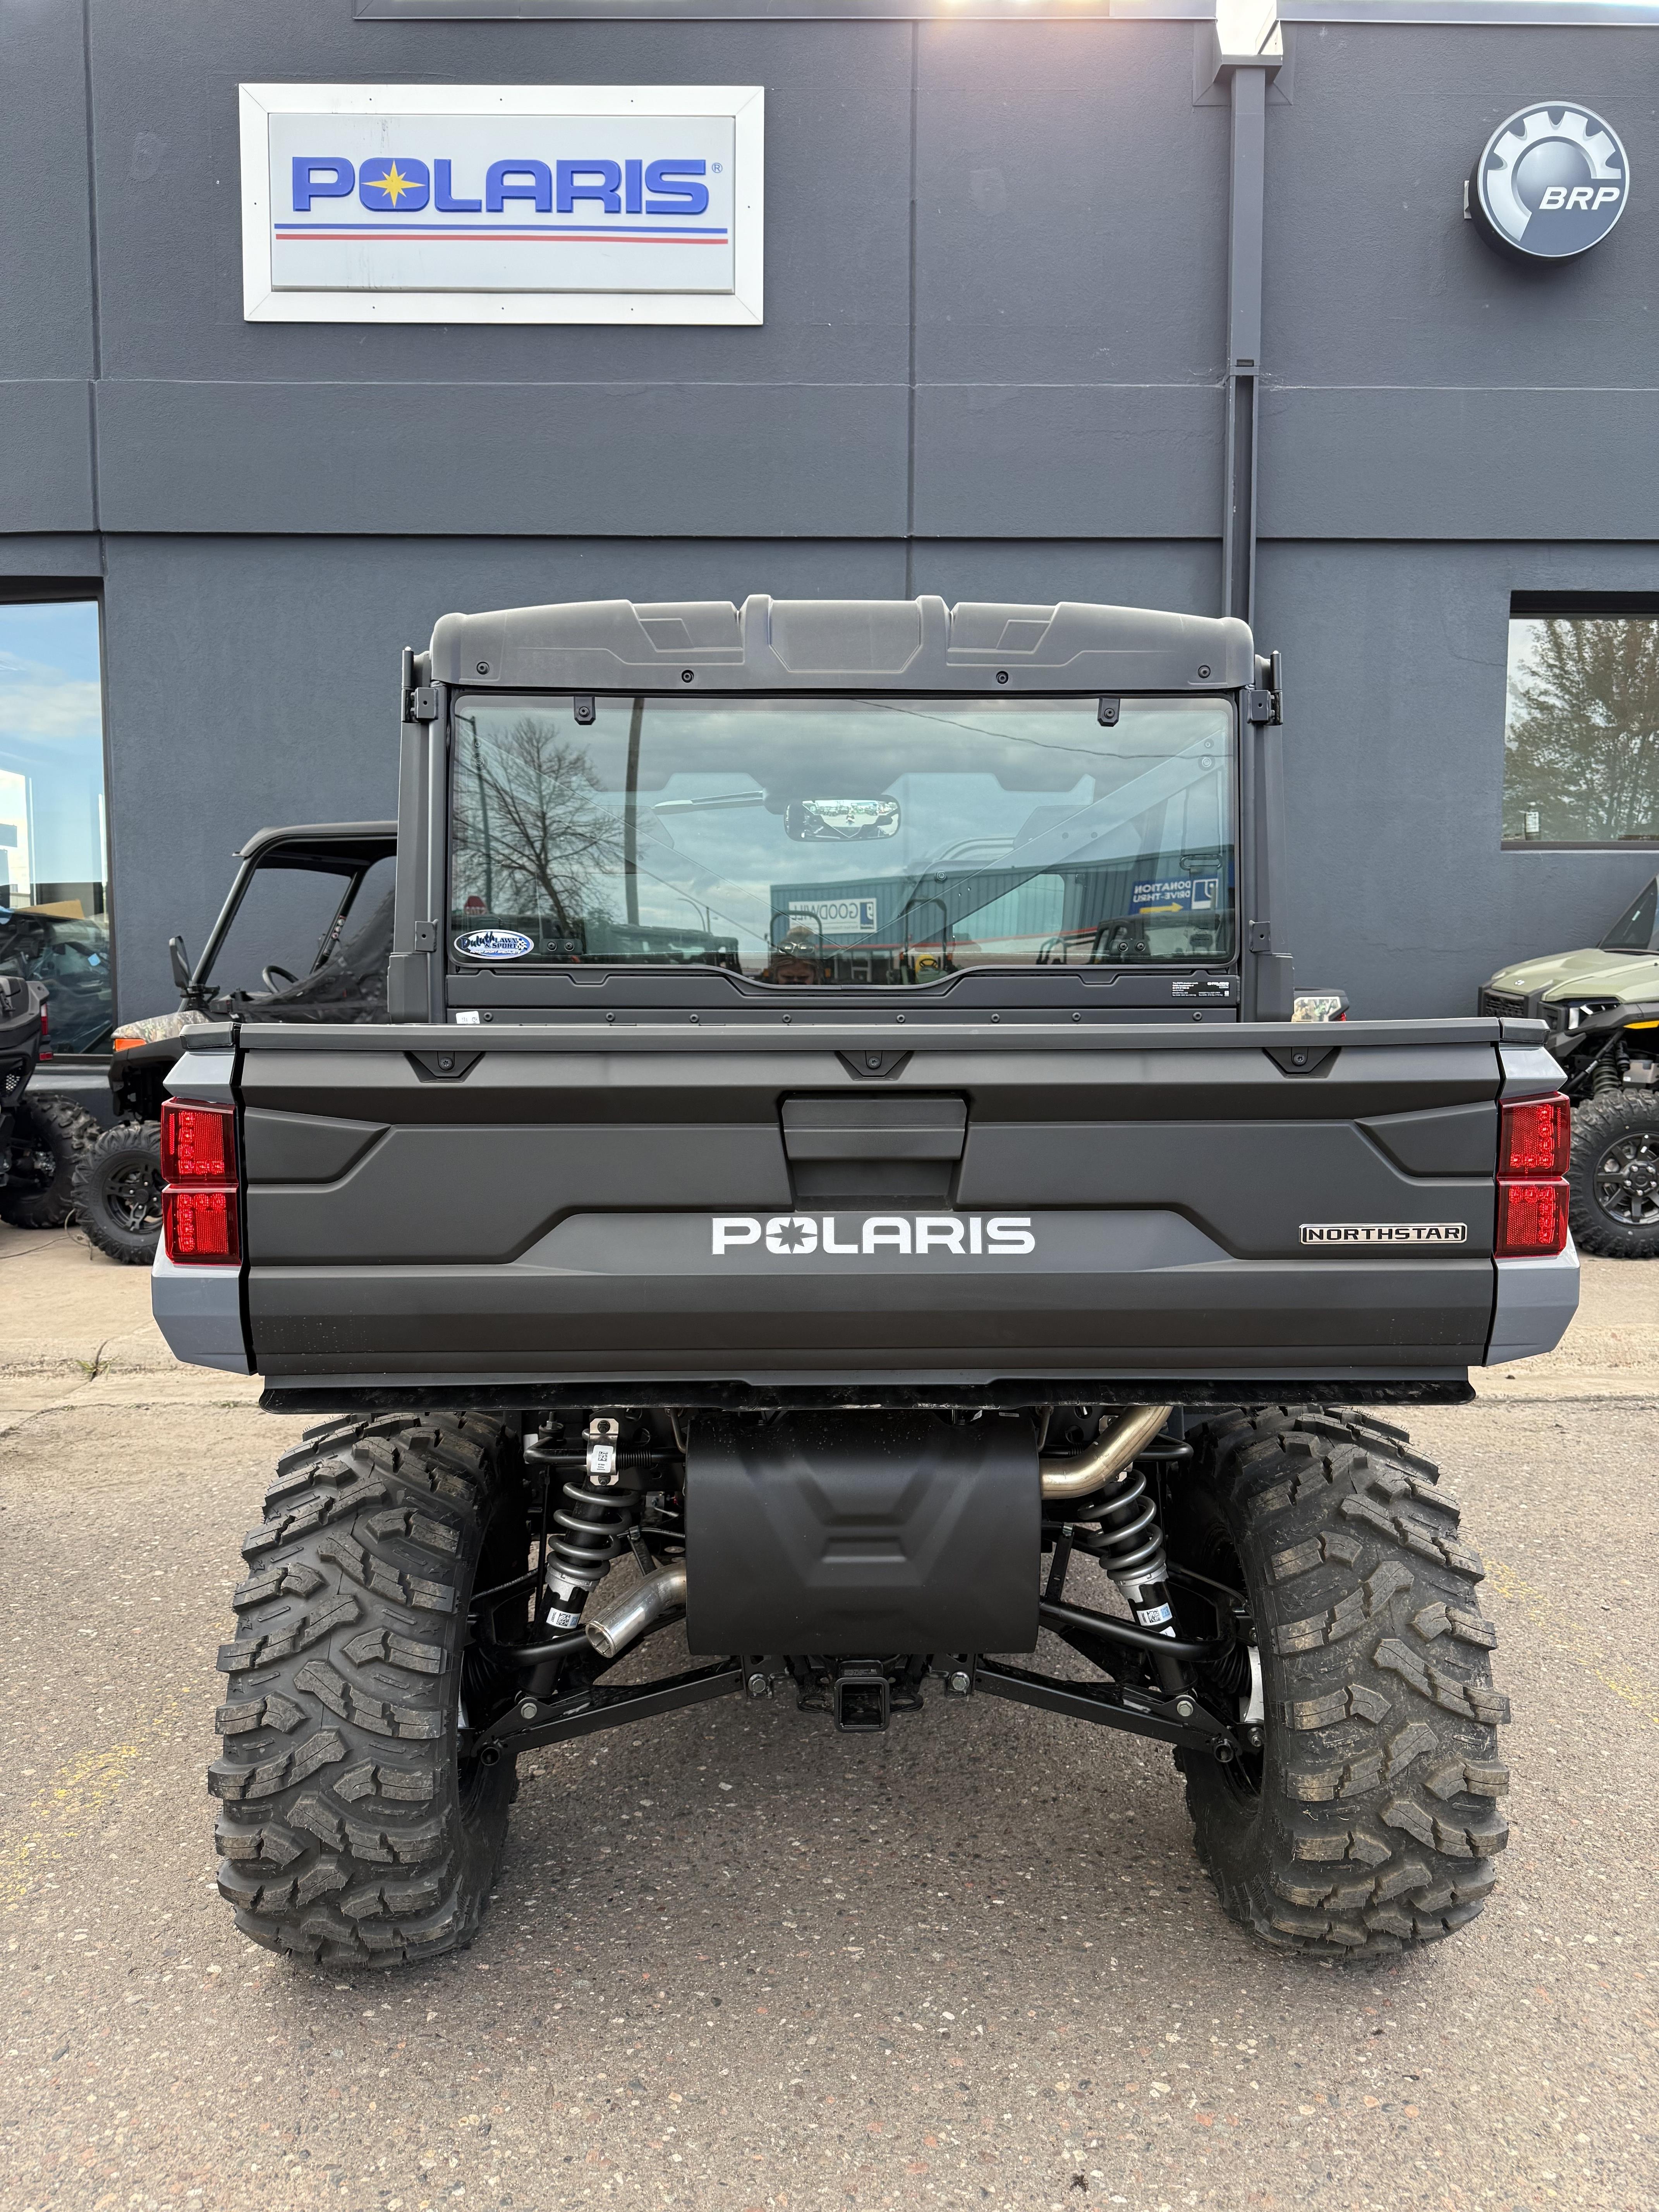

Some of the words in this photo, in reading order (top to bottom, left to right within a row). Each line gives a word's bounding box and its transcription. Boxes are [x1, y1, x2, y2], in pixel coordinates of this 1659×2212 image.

[292, 156, 709, 215] POLARIS
[1539, 186, 1620, 210] BRP
[460, 931, 495, 949] Duluth
[711, 1217, 1036, 1255] POLARIS
[1308, 1228, 1460, 1240] NORTHSTAR
